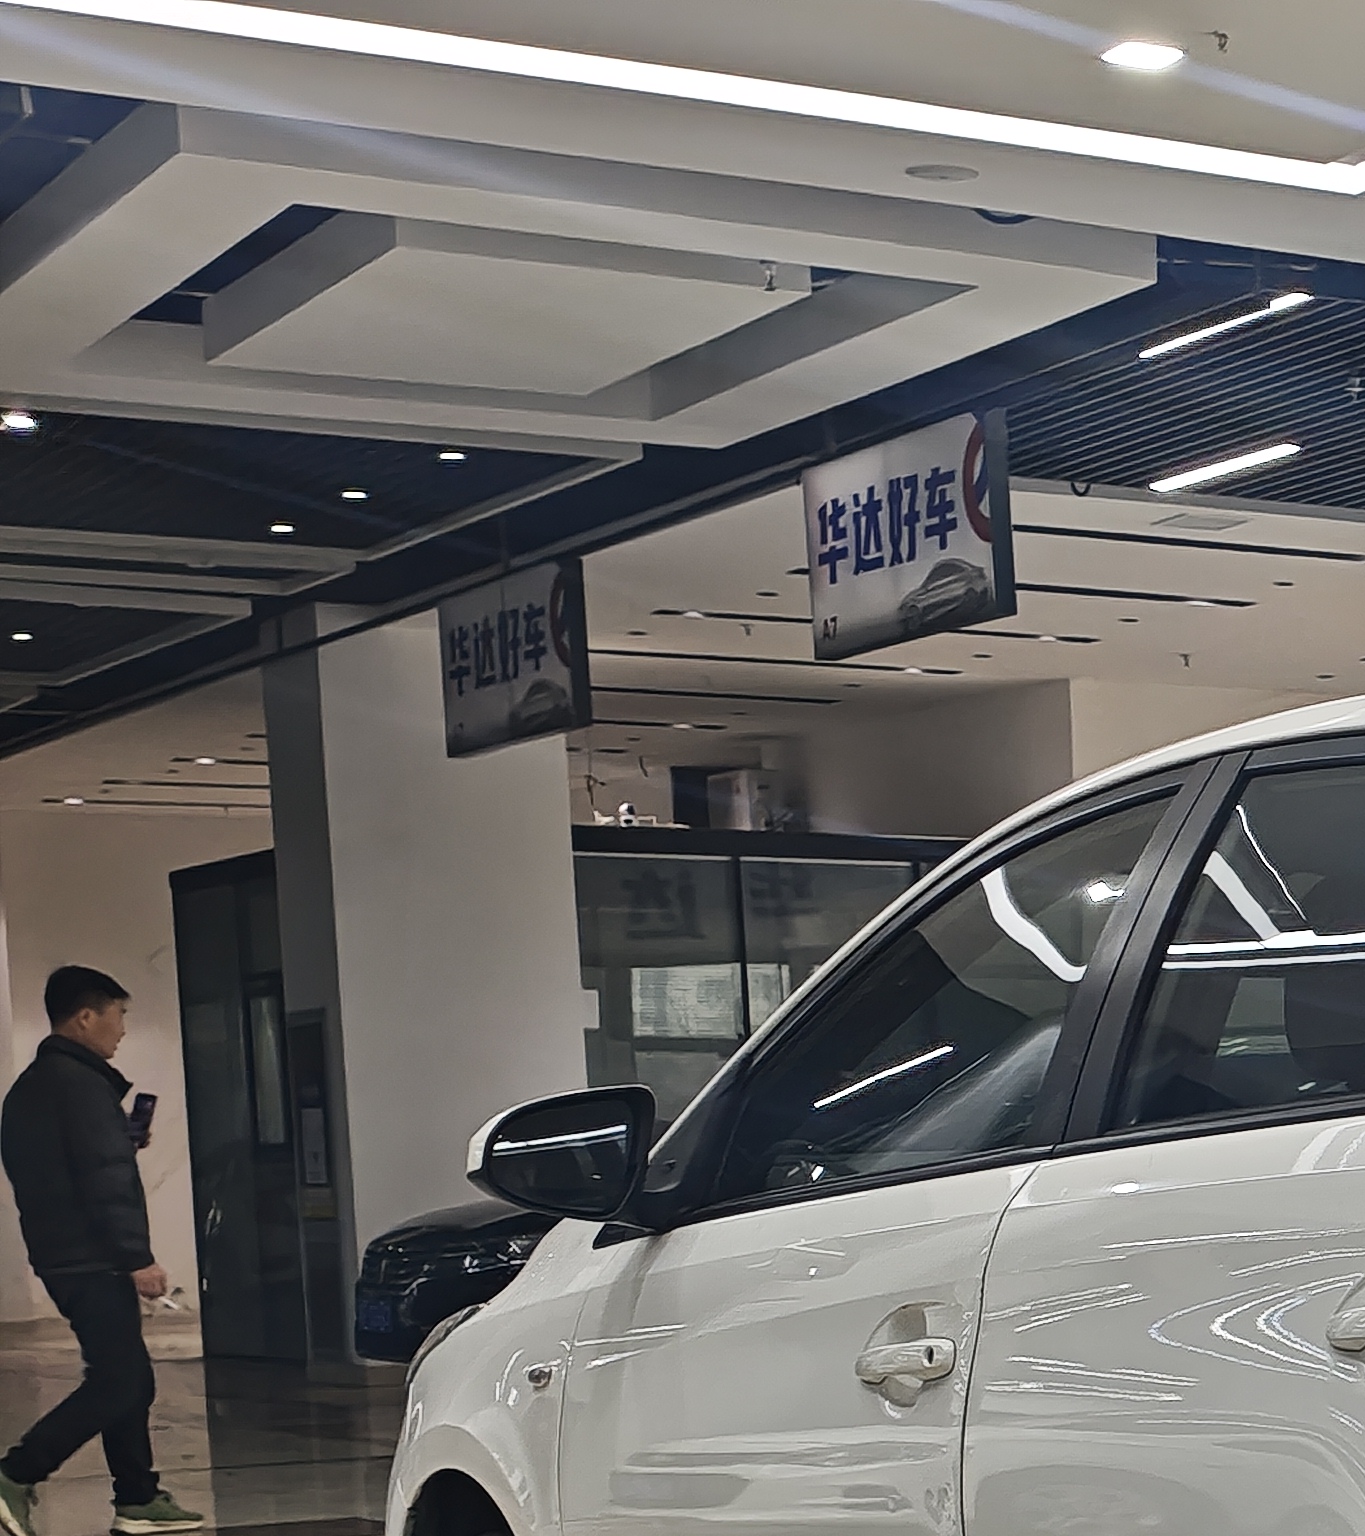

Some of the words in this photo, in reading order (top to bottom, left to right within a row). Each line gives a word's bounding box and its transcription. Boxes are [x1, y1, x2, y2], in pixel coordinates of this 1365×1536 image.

[817, 466, 959, 586] 华达好车
[449, 601, 548, 697] 华达好车
